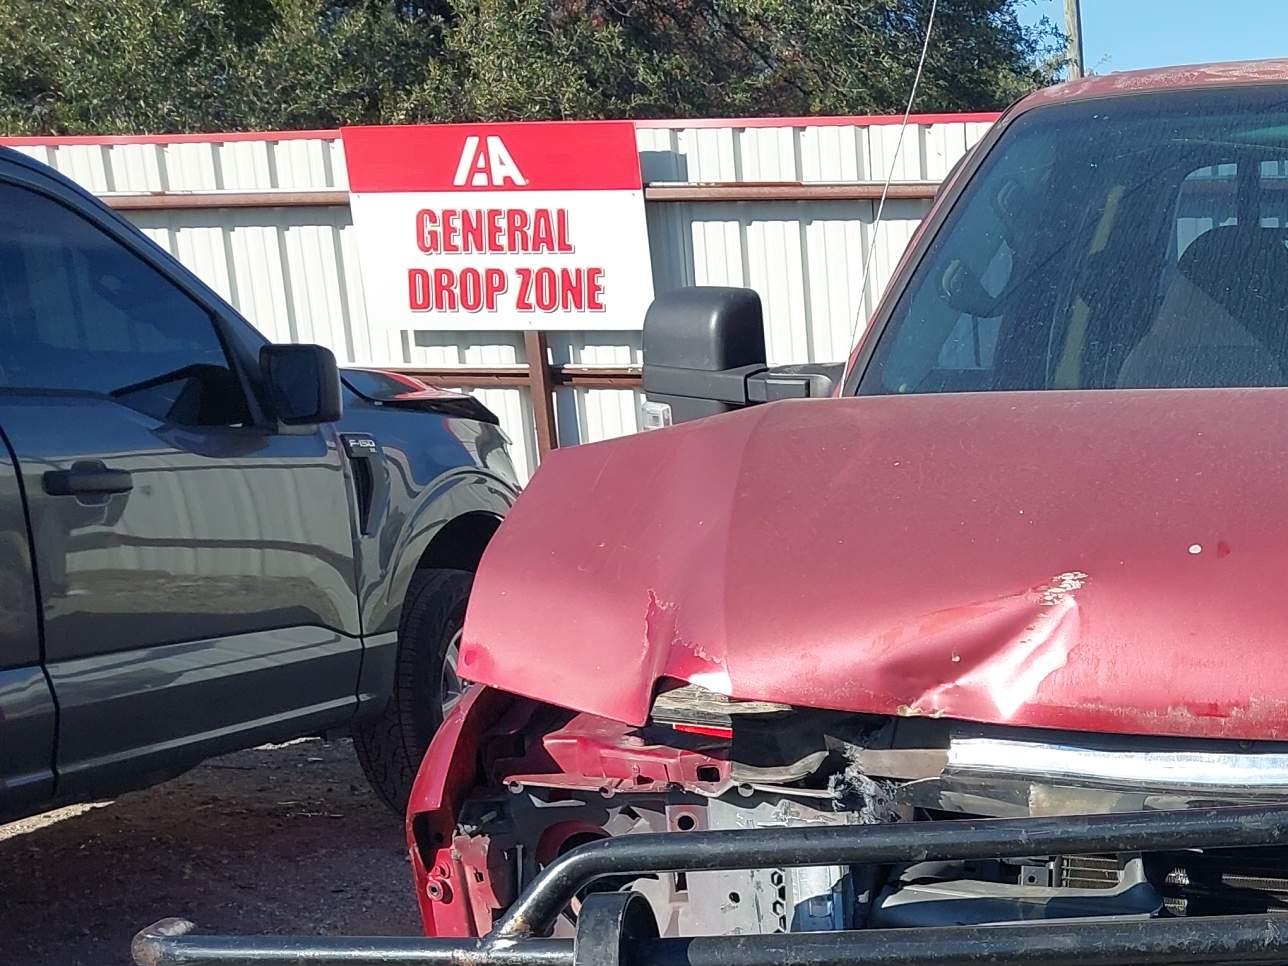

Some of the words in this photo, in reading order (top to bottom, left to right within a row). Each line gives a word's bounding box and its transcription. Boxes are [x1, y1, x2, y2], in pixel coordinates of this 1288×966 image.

[416, 208, 575, 254] GENERAL
[408, 267, 508, 313] DROP
[515, 267, 606, 313] ZONE
